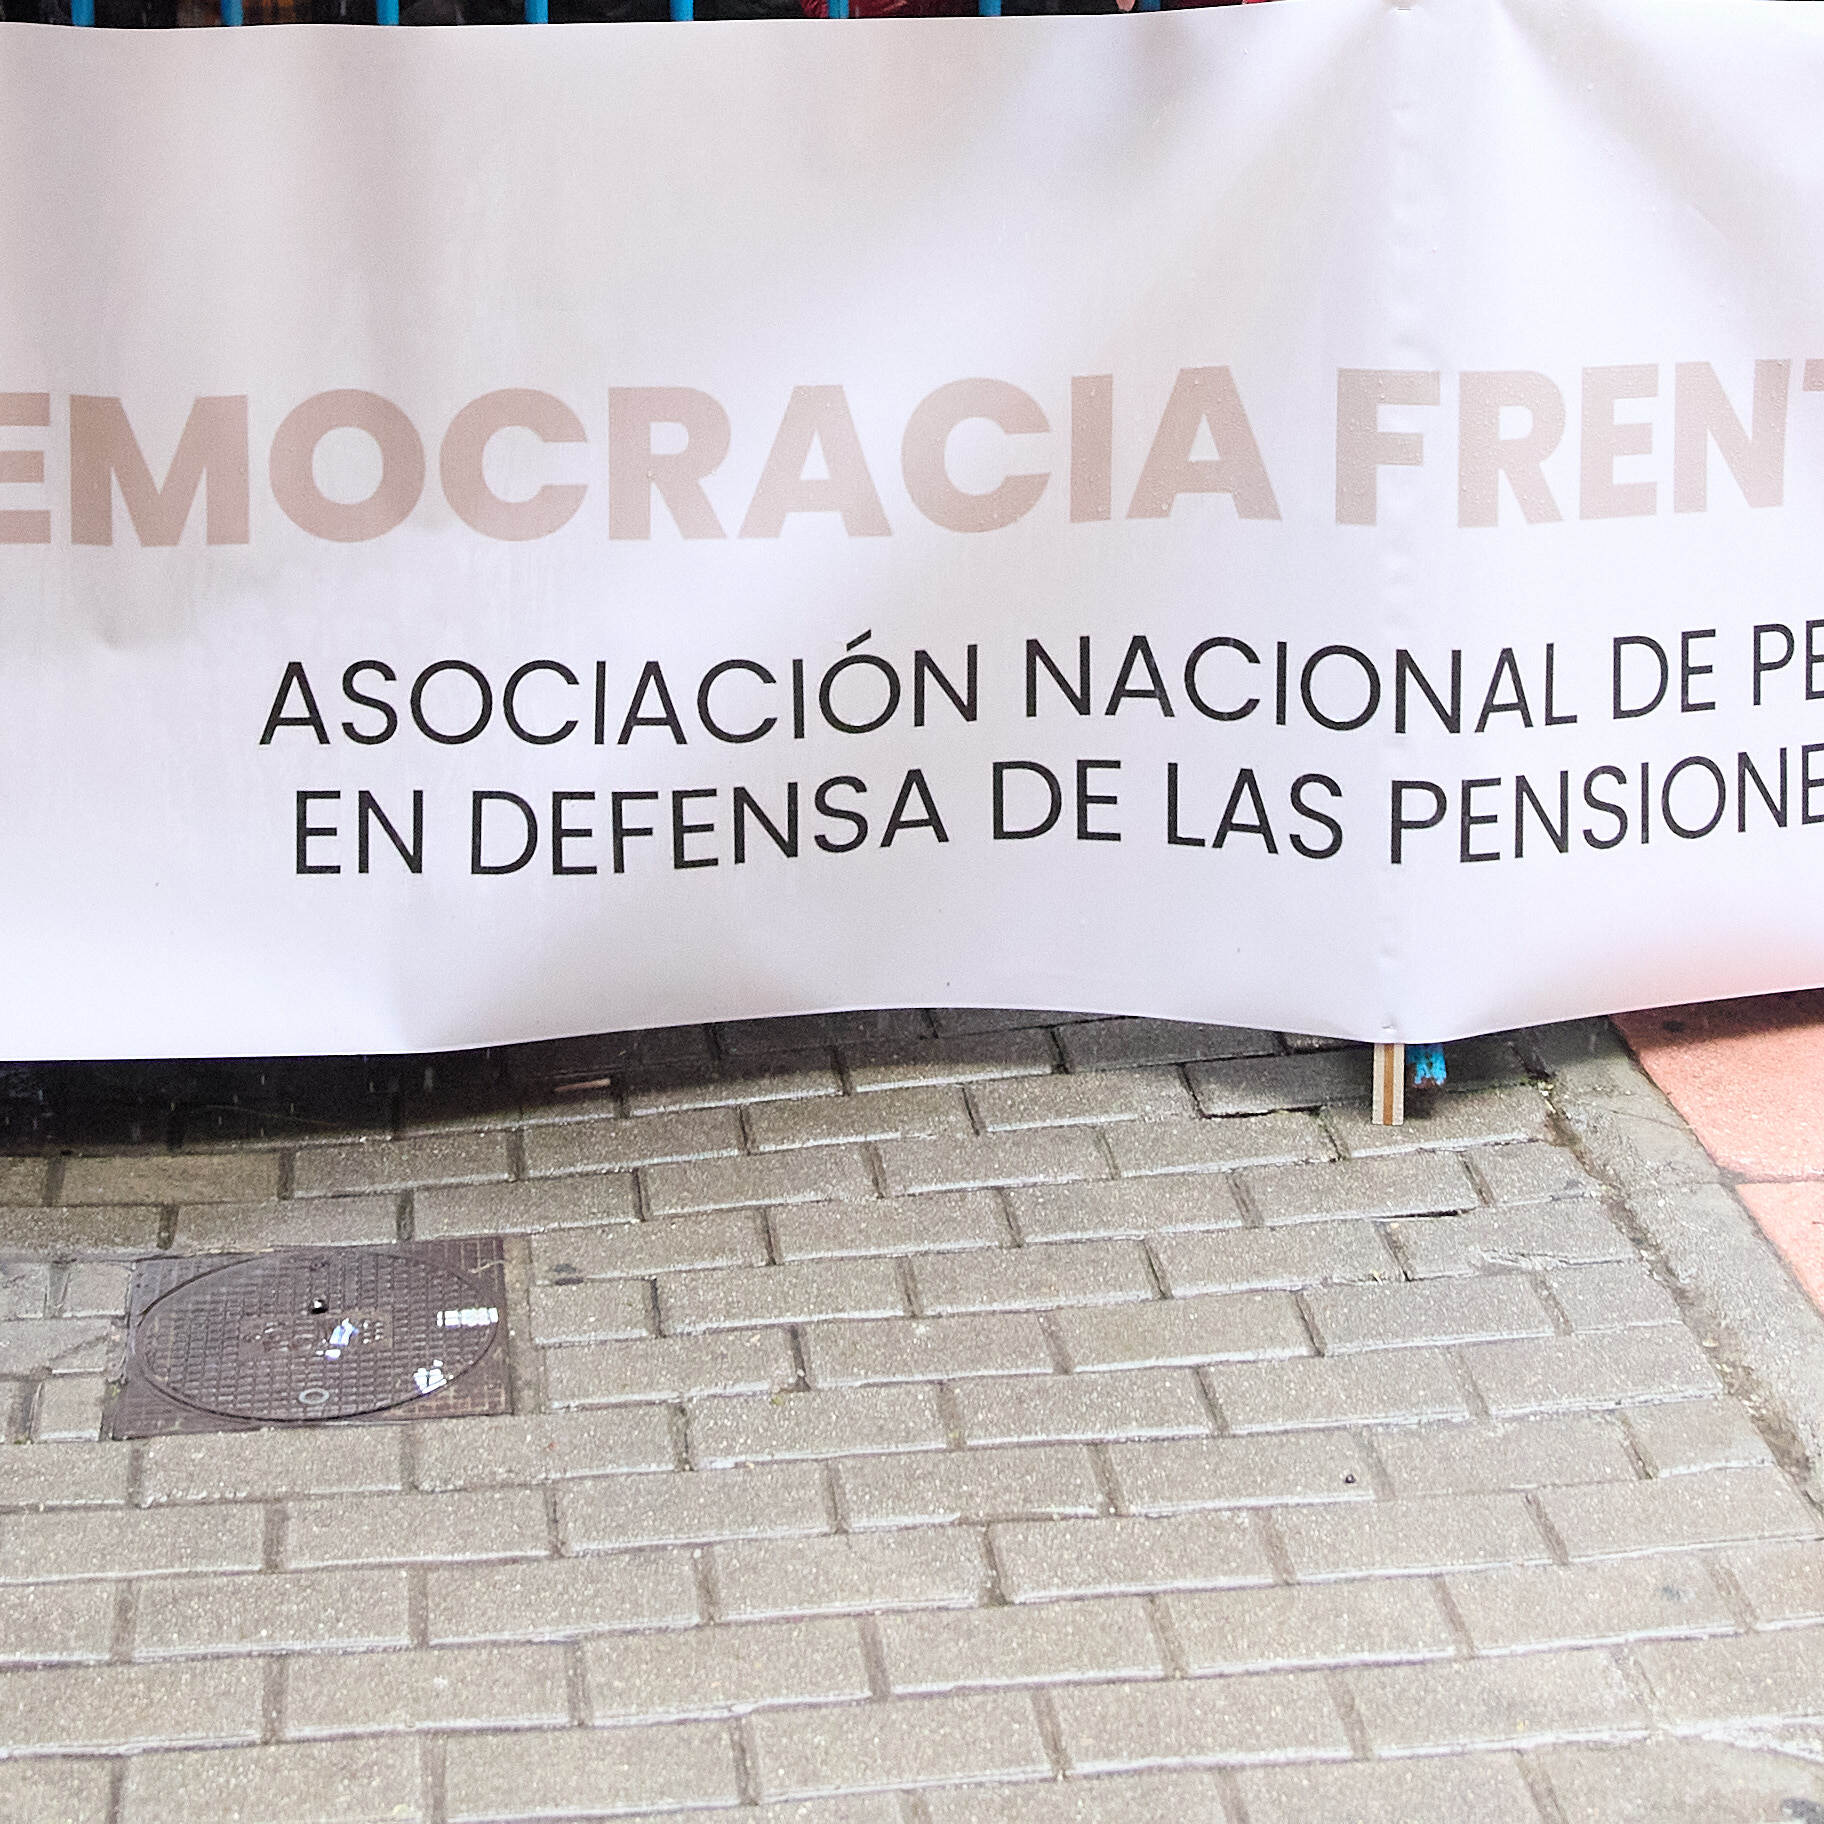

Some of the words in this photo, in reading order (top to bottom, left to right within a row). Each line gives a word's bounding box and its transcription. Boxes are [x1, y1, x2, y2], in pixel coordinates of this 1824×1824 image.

[260, 629, 978, 746] ASOCIACIÓN
[1026, 636, 1578, 734] NACIONAL
[1614, 629, 1716, 720] DE
[297, 789, 424, 875] EN
[471, 769, 950, 876] DEFENSA
[993, 760, 1122, 842] DE
[1168, 763, 1343, 860] LAS
